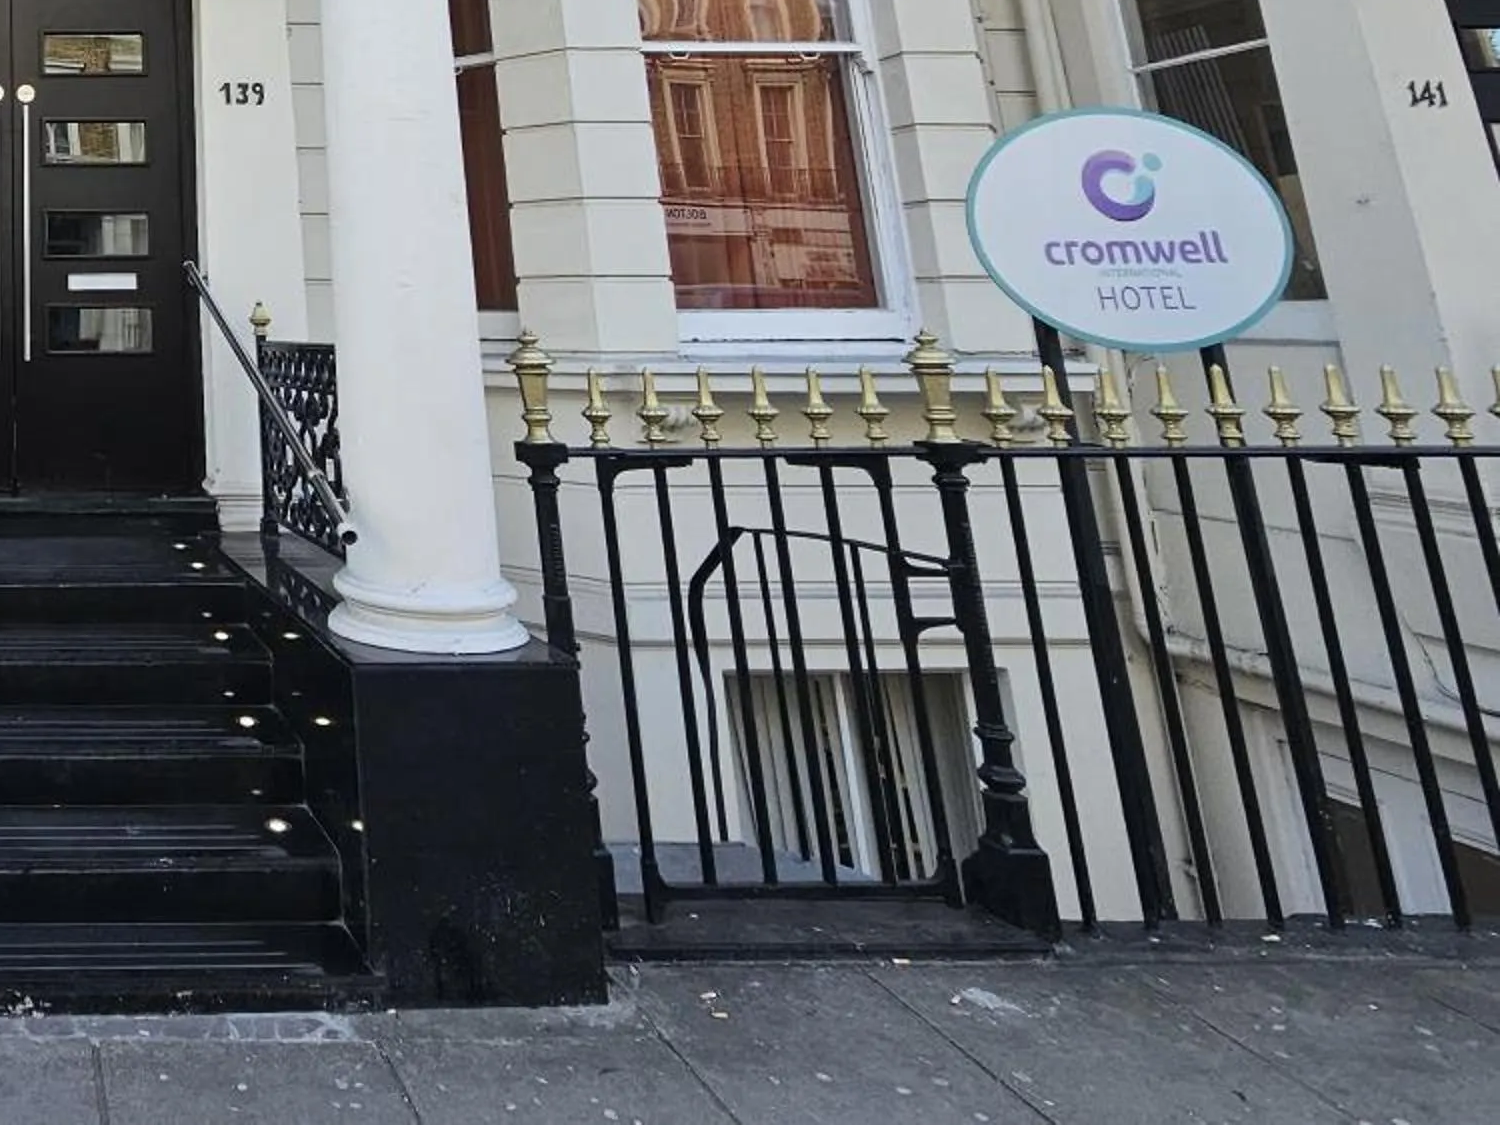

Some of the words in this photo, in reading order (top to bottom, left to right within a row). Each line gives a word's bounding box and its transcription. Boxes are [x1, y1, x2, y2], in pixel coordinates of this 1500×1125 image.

[219, 82, 264, 105] 139
[1407, 80, 1448, 107] 141
[1044, 230, 1228, 265] cromwell
[1097, 286, 1197, 311] HOTEL
